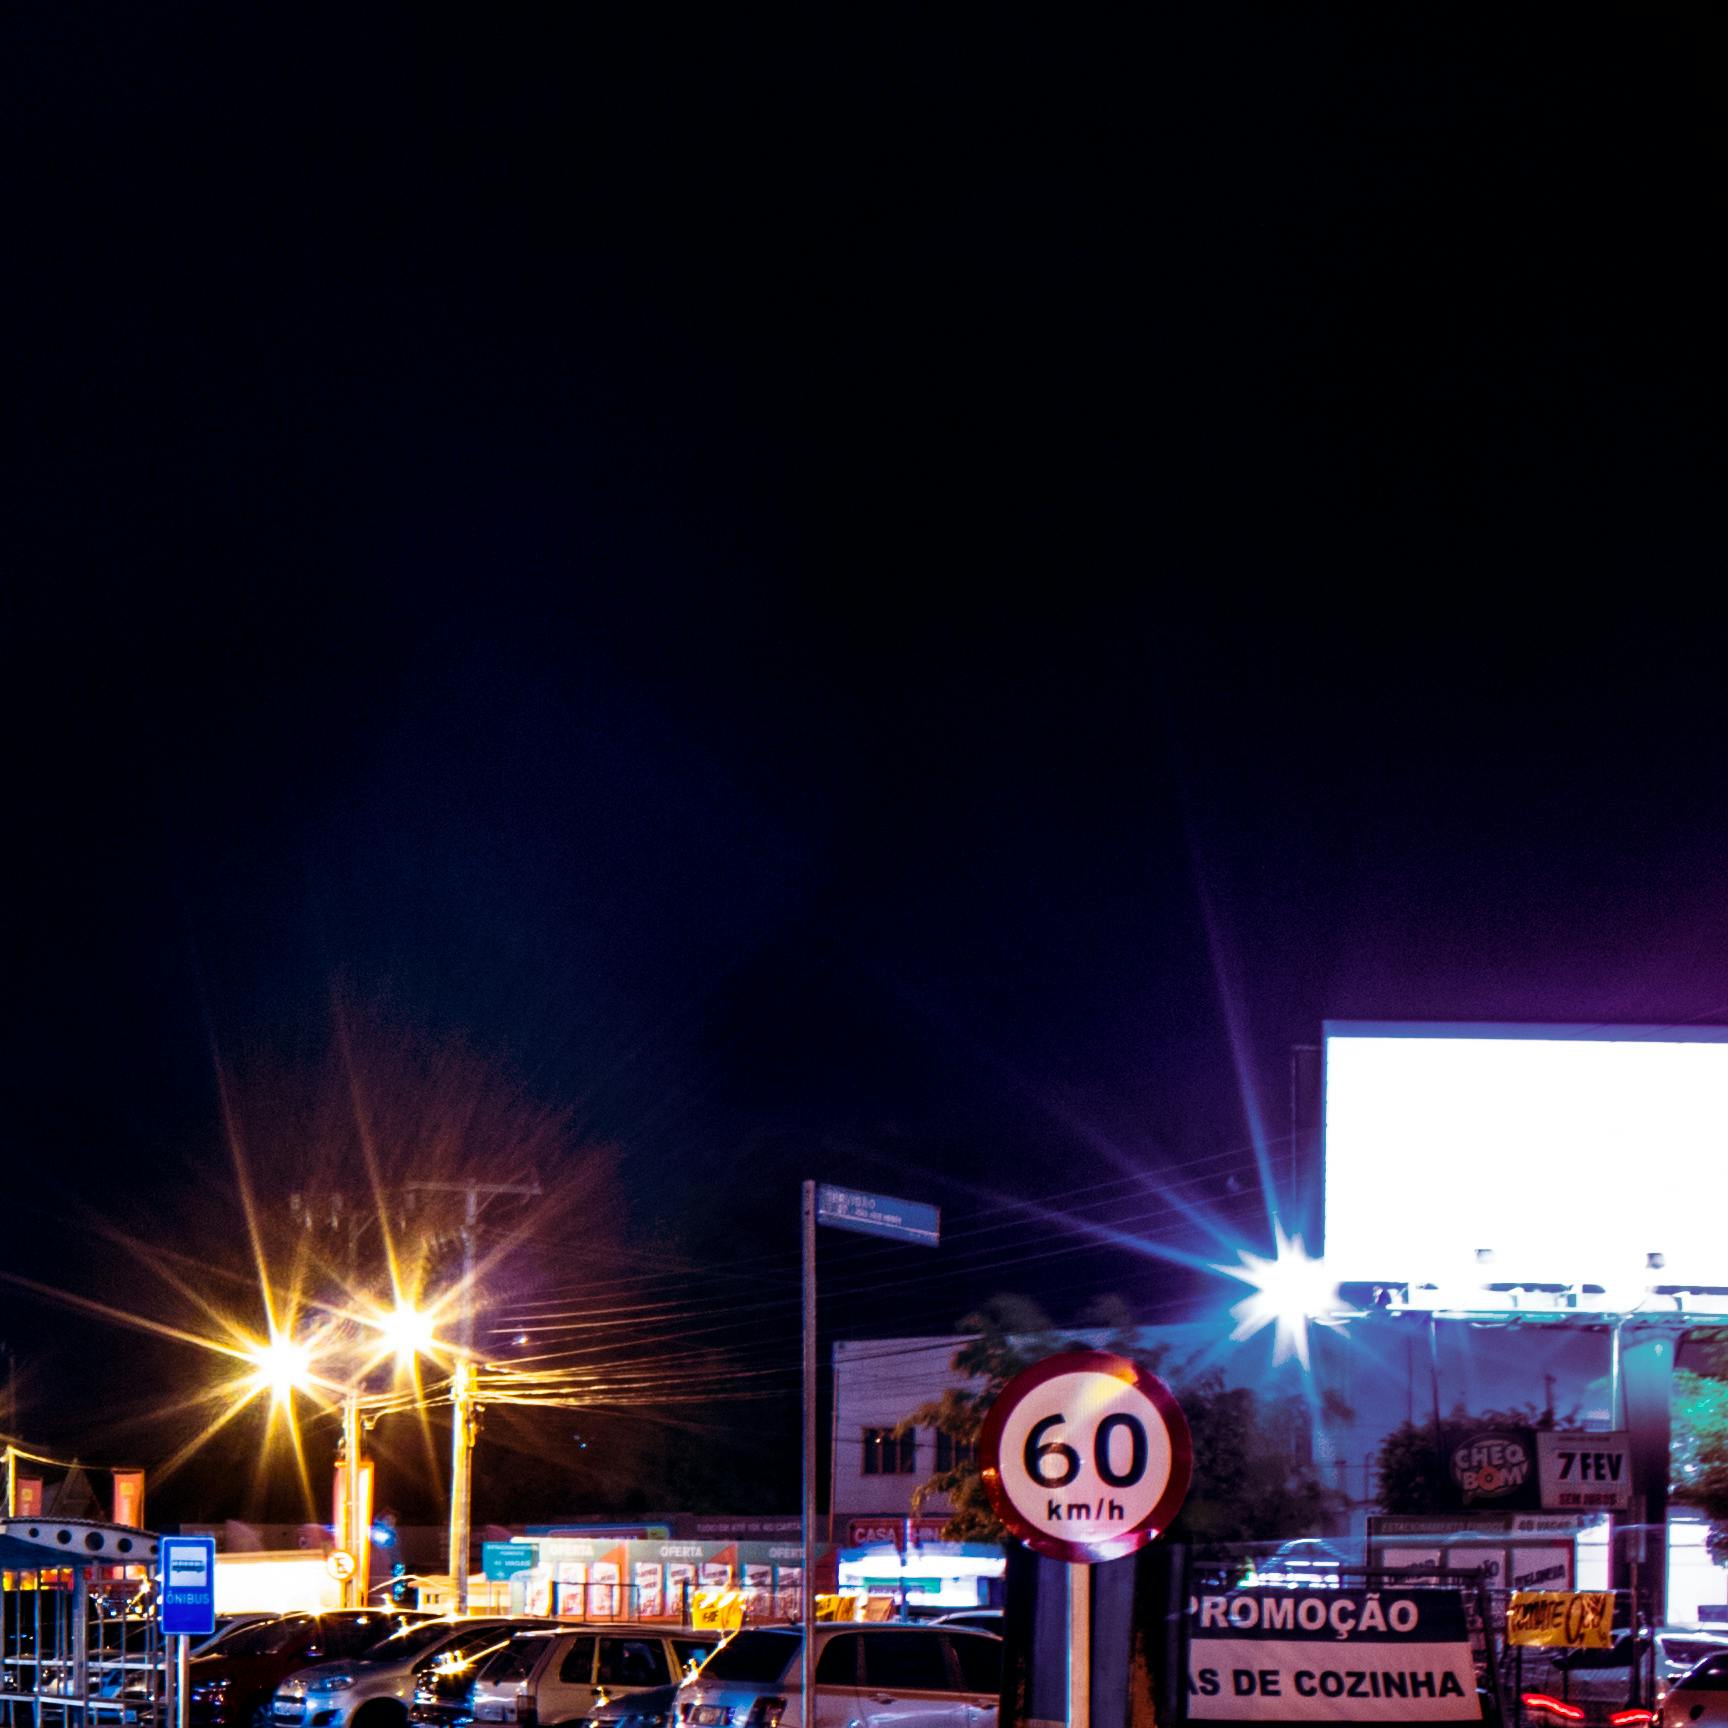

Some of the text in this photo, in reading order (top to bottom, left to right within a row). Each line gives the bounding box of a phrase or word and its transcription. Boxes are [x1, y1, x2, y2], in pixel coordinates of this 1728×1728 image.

[1023, 1412, 1149, 1489] 60
[1455, 1443, 1526, 1470] CHEQ
[1558, 1452, 1623, 1481] 7 FEV
[1047, 1498, 1125, 1521] km/h
[854, 1528, 896, 1543] CASA
[660, 1545, 703, 1558] OFERTA
[166, 1590, 210, 1605] ÔNIBUS
[1232, 1669, 1282, 1696] DE
[1294, 1670, 1466, 1698] COZINHA
